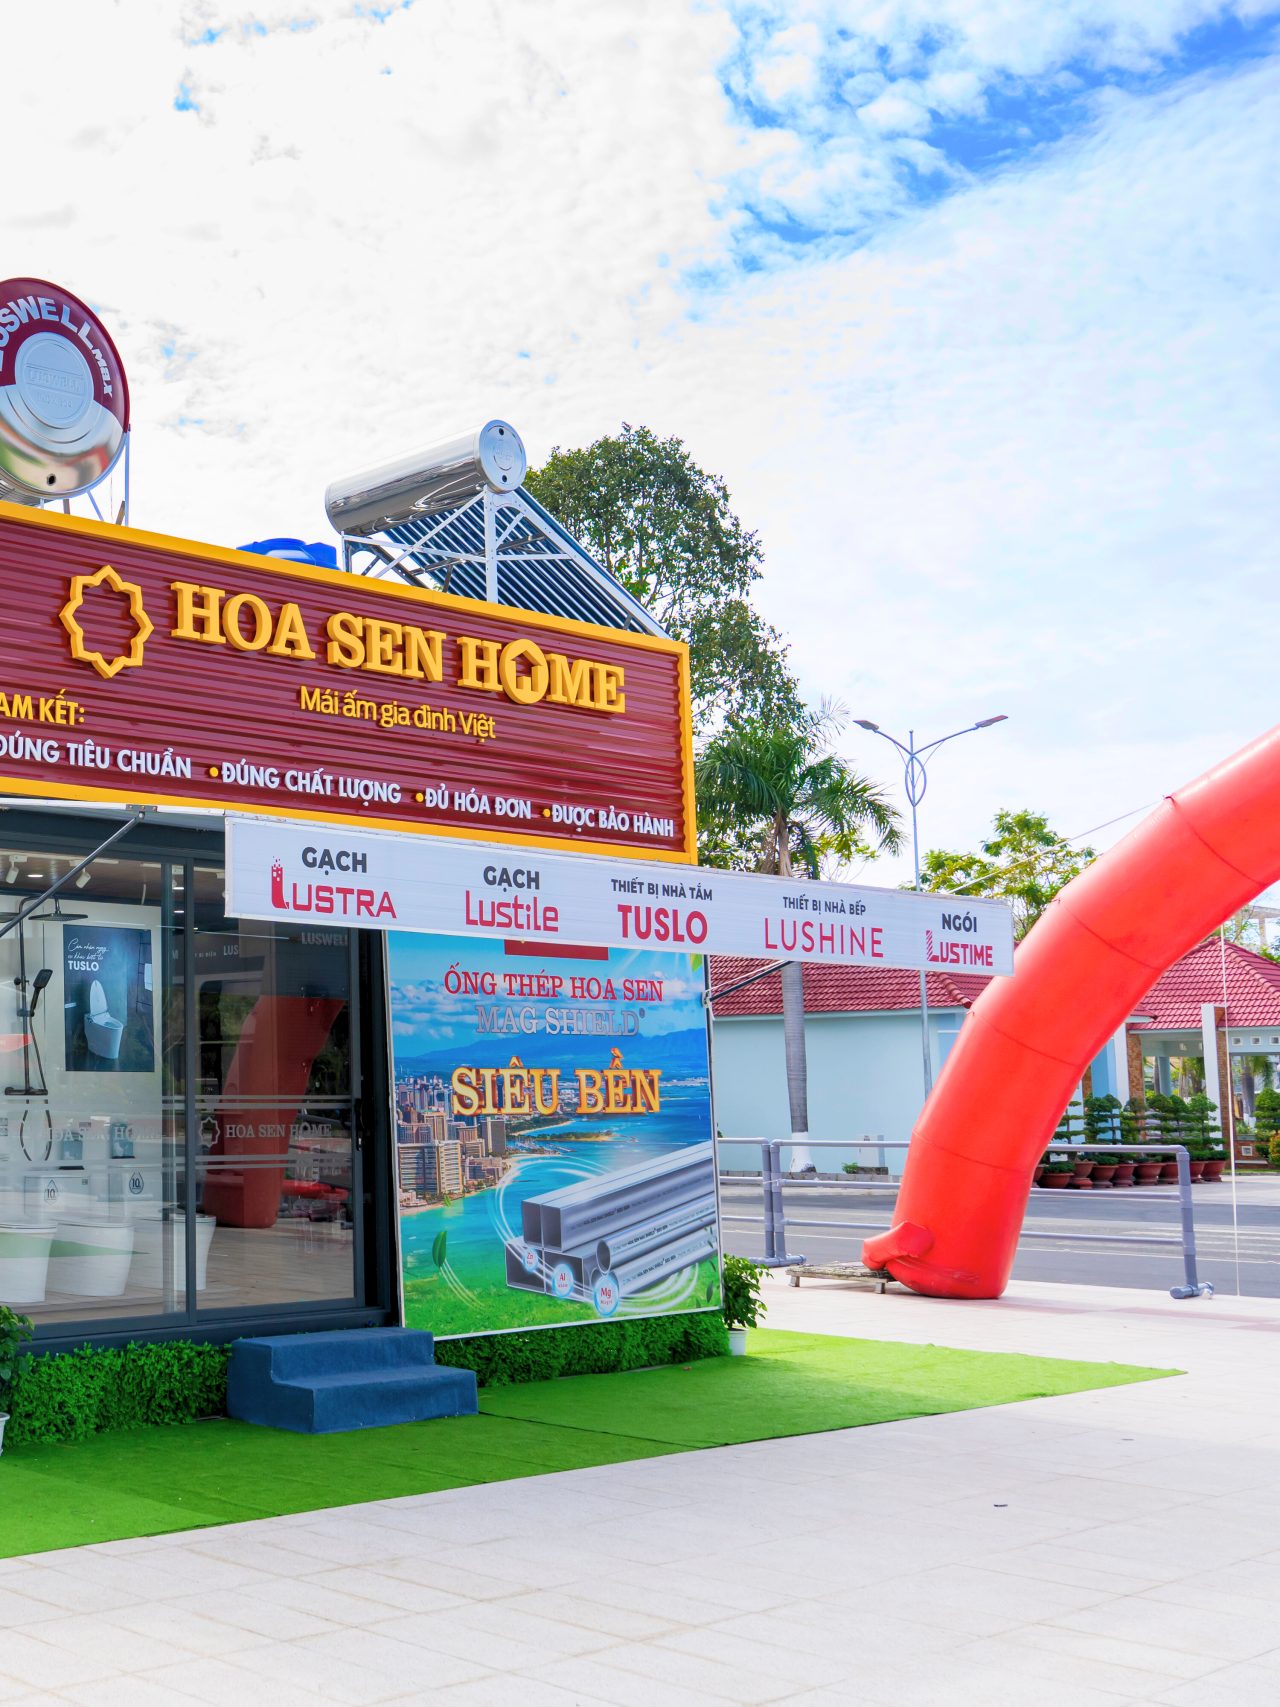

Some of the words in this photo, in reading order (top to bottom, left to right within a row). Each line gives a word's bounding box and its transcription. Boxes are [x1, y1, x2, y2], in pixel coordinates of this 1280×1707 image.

[171, 580, 316, 661] HOA
[327, 611, 447, 683] SEN
[457, 638, 626, 714] HOME
[39, 688, 85, 726] KẾT:
[300, 685, 339, 715] Mái
[342, 689, 377, 721] ấm
[380, 701, 410, 729] gia
[413, 704, 456, 733] đình
[457, 711, 496, 743] Việt
[66, 738, 110, 769] TIÊU
[117, 747, 192, 779] CHUẨN
[221, 758, 280, 789] ĐÚNG
[285, 767, 333, 796] CHẤT
[338, 776, 402, 807] LƯỢNG
[425, 782, 449, 810] ĐỦ
[454, 787, 491, 815] HÓA
[495, 796, 531, 820] ĐƠN
[551, 804, 595, 832] ĐƯỢC
[598, 805, 629, 832] BẢO
[633, 812, 674, 838] HÀNH
[301, 846, 367, 876] GẠCH
[483, 865, 540, 892] GẠCH
[271, 857, 397, 919] LUSTRA
[611, 877, 645, 894] THIẾT
[647, 883, 659, 899] BỊ
[662, 883, 686, 899] NHÀ
[688, 882, 713, 900] TẮM
[782, 894, 810, 911] THIẾT
[812, 899, 822, 915] BỊ
[825, 899, 847, 914] NHÀ
[849, 899, 867, 916] BẾP
[465, 889, 559, 933] Lustile
[617, 904, 708, 944] TUSLO
[942, 911, 977, 932] NGÓI
[764, 917, 884, 958] LUSHINE
[925, 930, 993, 966] LUSTIME
[68, 960, 99, 971] TUSLO
[444, 962, 497, 996] ỐNG
[504, 969, 563, 998] THÉP
[570, 976, 617, 1000] HOA
[623, 979, 663, 1001] SEN
[475, 1005, 537, 1034] MAG
[451, 1055, 560, 1116] SIÊU
[576, 1047, 663, 1115] BỀN
[226, 1124, 255, 1138] HOA
[259, 1123, 286, 1138] SEN
[289, 1121, 332, 1138] HOME
[600, 1287, 612, 1299] Mg
